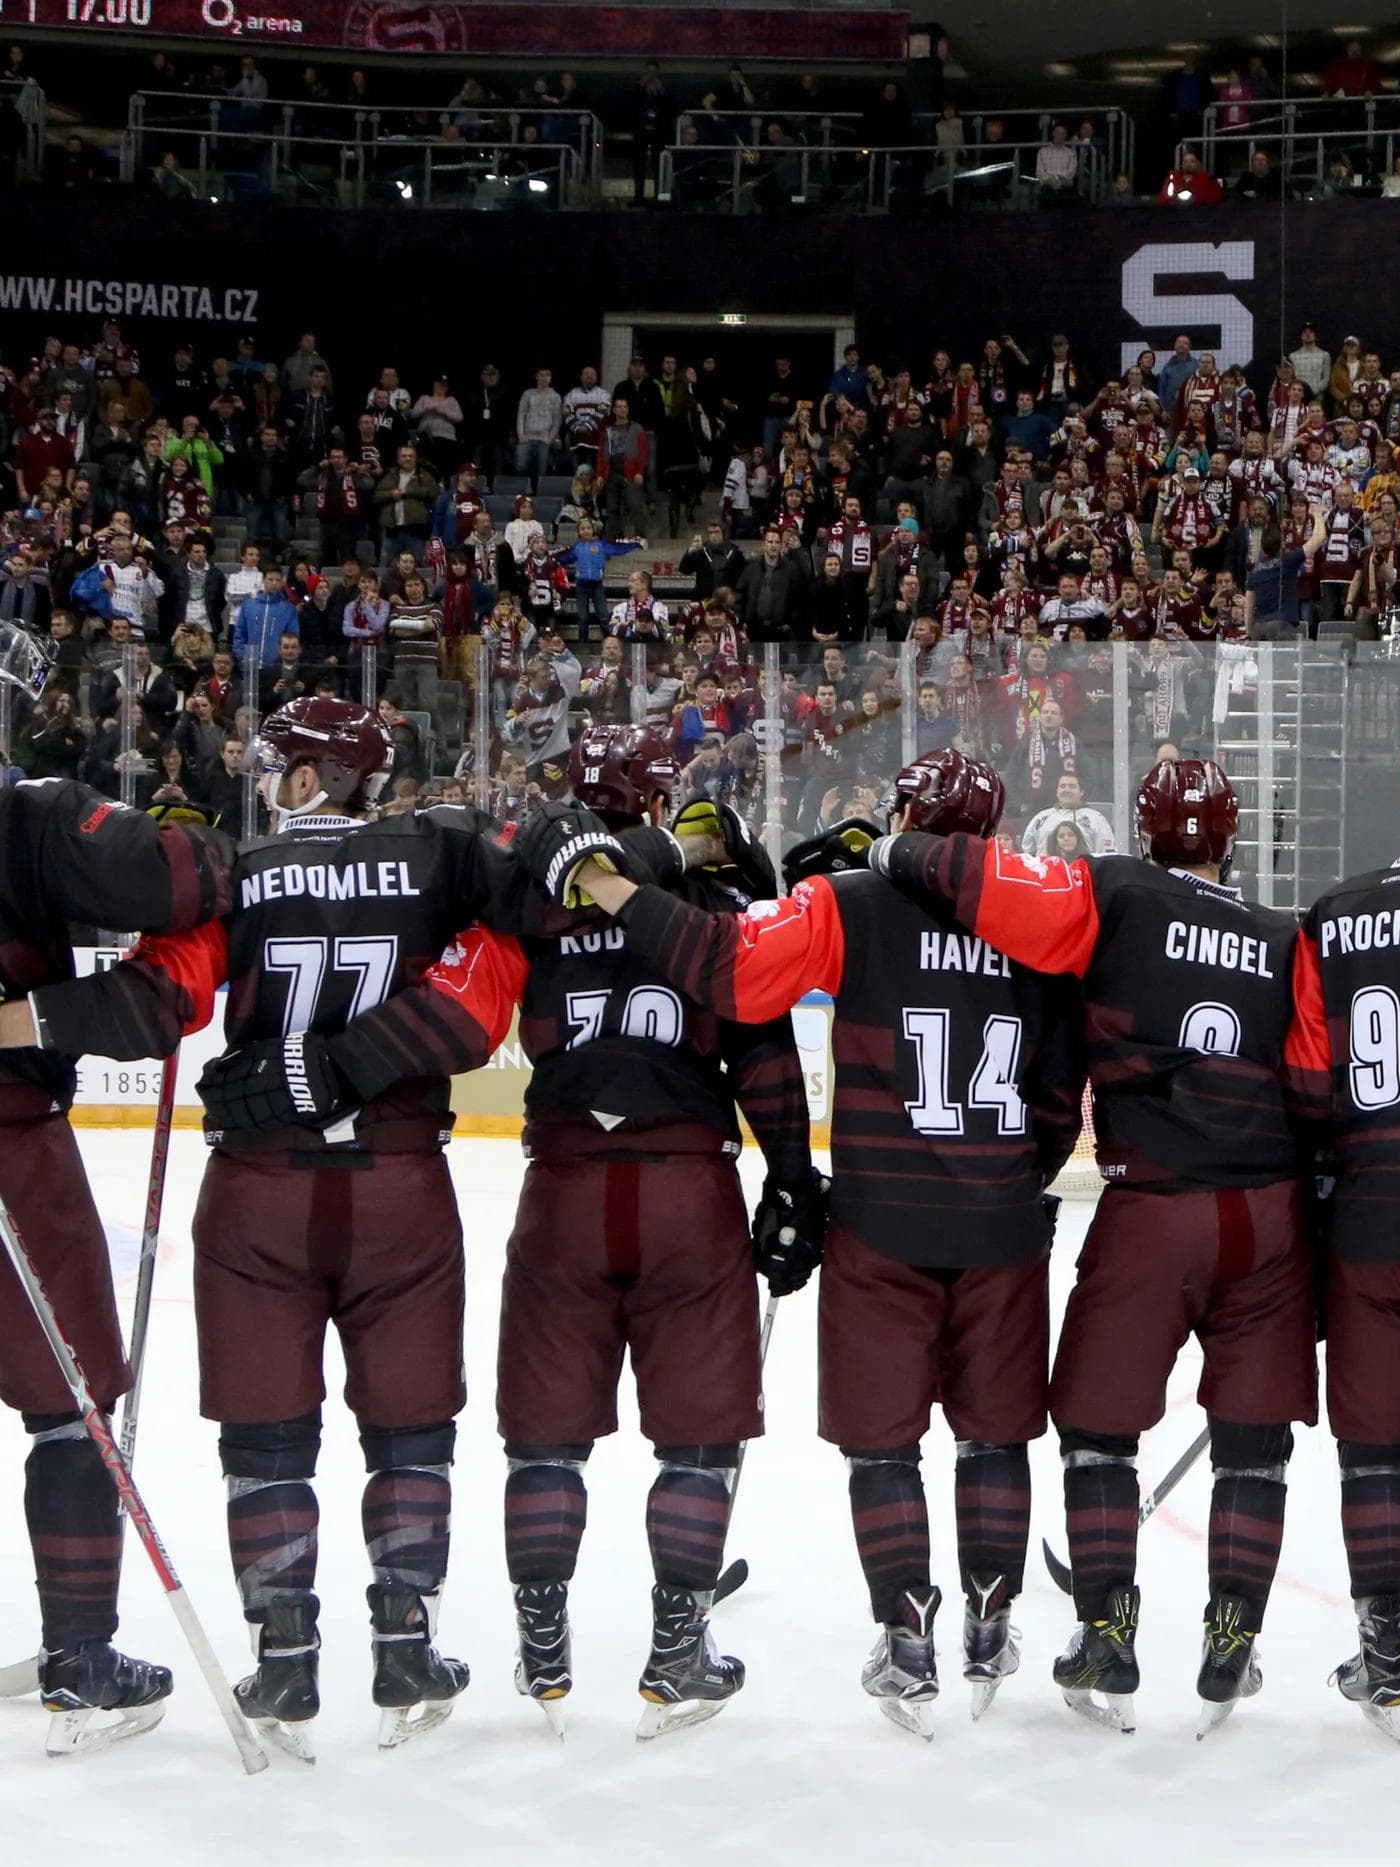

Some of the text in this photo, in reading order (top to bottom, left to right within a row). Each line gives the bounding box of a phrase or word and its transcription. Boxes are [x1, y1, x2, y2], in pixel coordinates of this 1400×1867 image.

[247, 17, 302, 33] arena
[584, 766, 600, 784] 18
[1186, 817, 1198, 835] 6
[241, 861, 420, 909] NEDOMLEL
[1165, 921, 1274, 979] CINGEL
[264, 935, 399, 1034] 77
[102, 1072, 162, 1094] 1853
[283, 1031, 317, 1114] ARRIOR
[901, 1006, 1028, 1135] 14
